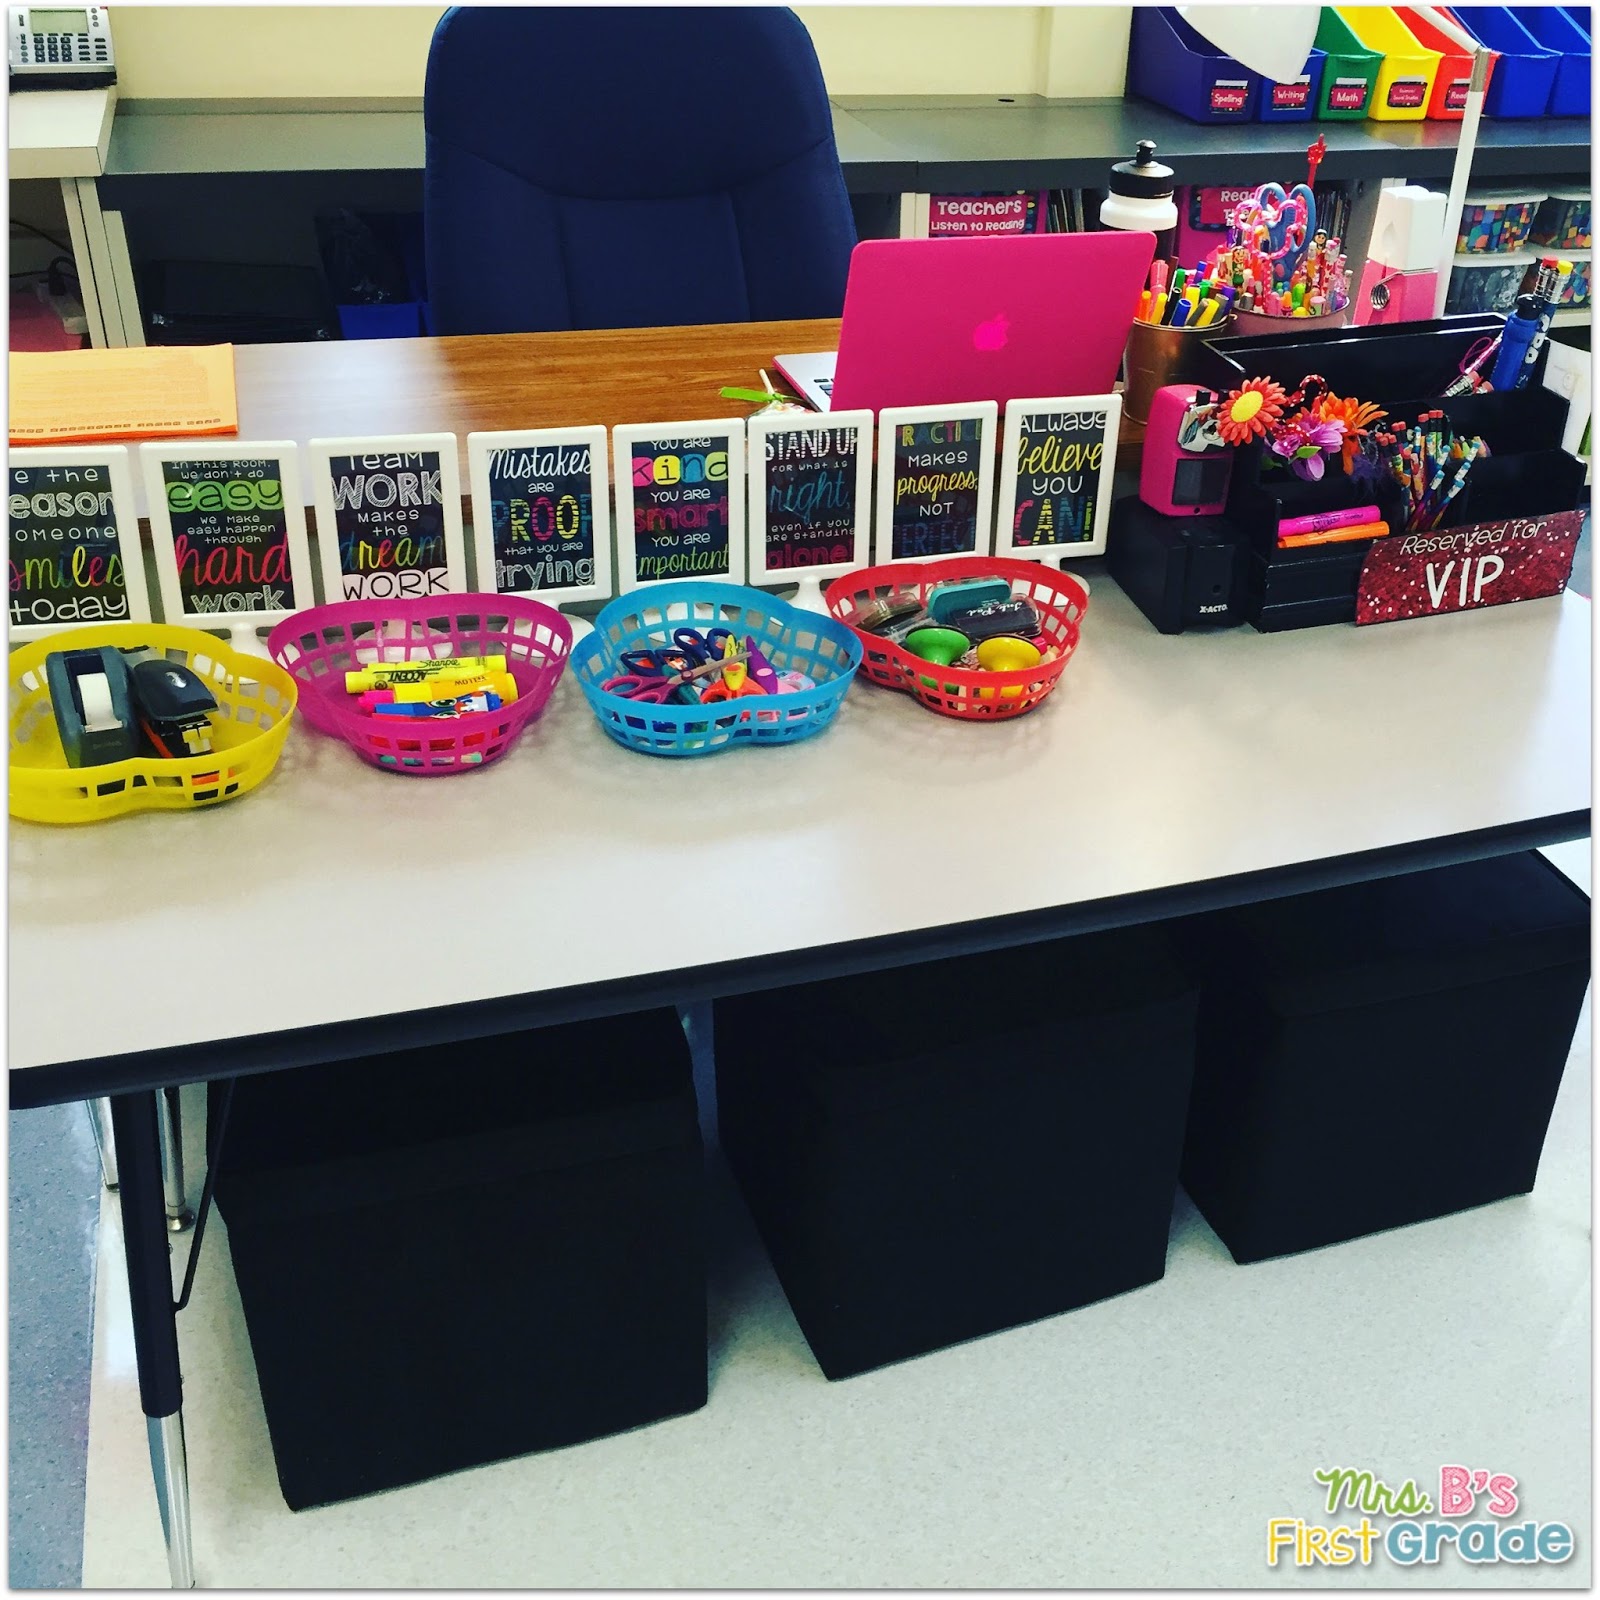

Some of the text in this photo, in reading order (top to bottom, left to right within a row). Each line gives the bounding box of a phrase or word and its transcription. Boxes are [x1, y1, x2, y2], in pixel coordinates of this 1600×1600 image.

[1214, 93, 1242, 105] Spelling
[1277, 90, 1305, 101] Writing
[1336, 92, 1358, 102] Math
[937, 200, 1022, 215] Teachers
[931, 219, 1025, 231] Listen to Reading
[766, 429, 831, 461] STAND
[1017, 435, 1104, 475] believe
[194, 460, 228, 469] this
[14, 468, 98, 483] e the
[181, 470, 198, 479] we
[247, 469, 264, 478] do
[168, 482, 282, 508] easy
[331, 470, 443, 510] WORK
[896, 470, 979, 505] progress,
[9, 491, 113, 519] eason
[920, 502, 954, 517] NOT
[634, 496, 728, 533] smart
[187, 526, 220, 535] easy
[372, 525, 408, 536] the
[771, 523, 802, 532] even
[808, 521, 821, 530] if
[1400, 519, 1548, 555] Reserved for
[340, 531, 447, 571] dream
[504, 546, 534, 555] that
[175, 532, 293, 586] hard
[496, 554, 595, 590] trying
[342, 571, 449, 600] WORK
[1426, 554, 1505, 609] VIP
[190, 585, 284, 613] work
[10, 594, 127, 622] today
[1199, 603, 1228, 613] X-ACTO
[417, 658, 461, 668] Sharpie
[388, 670, 427, 683] ACCENT
